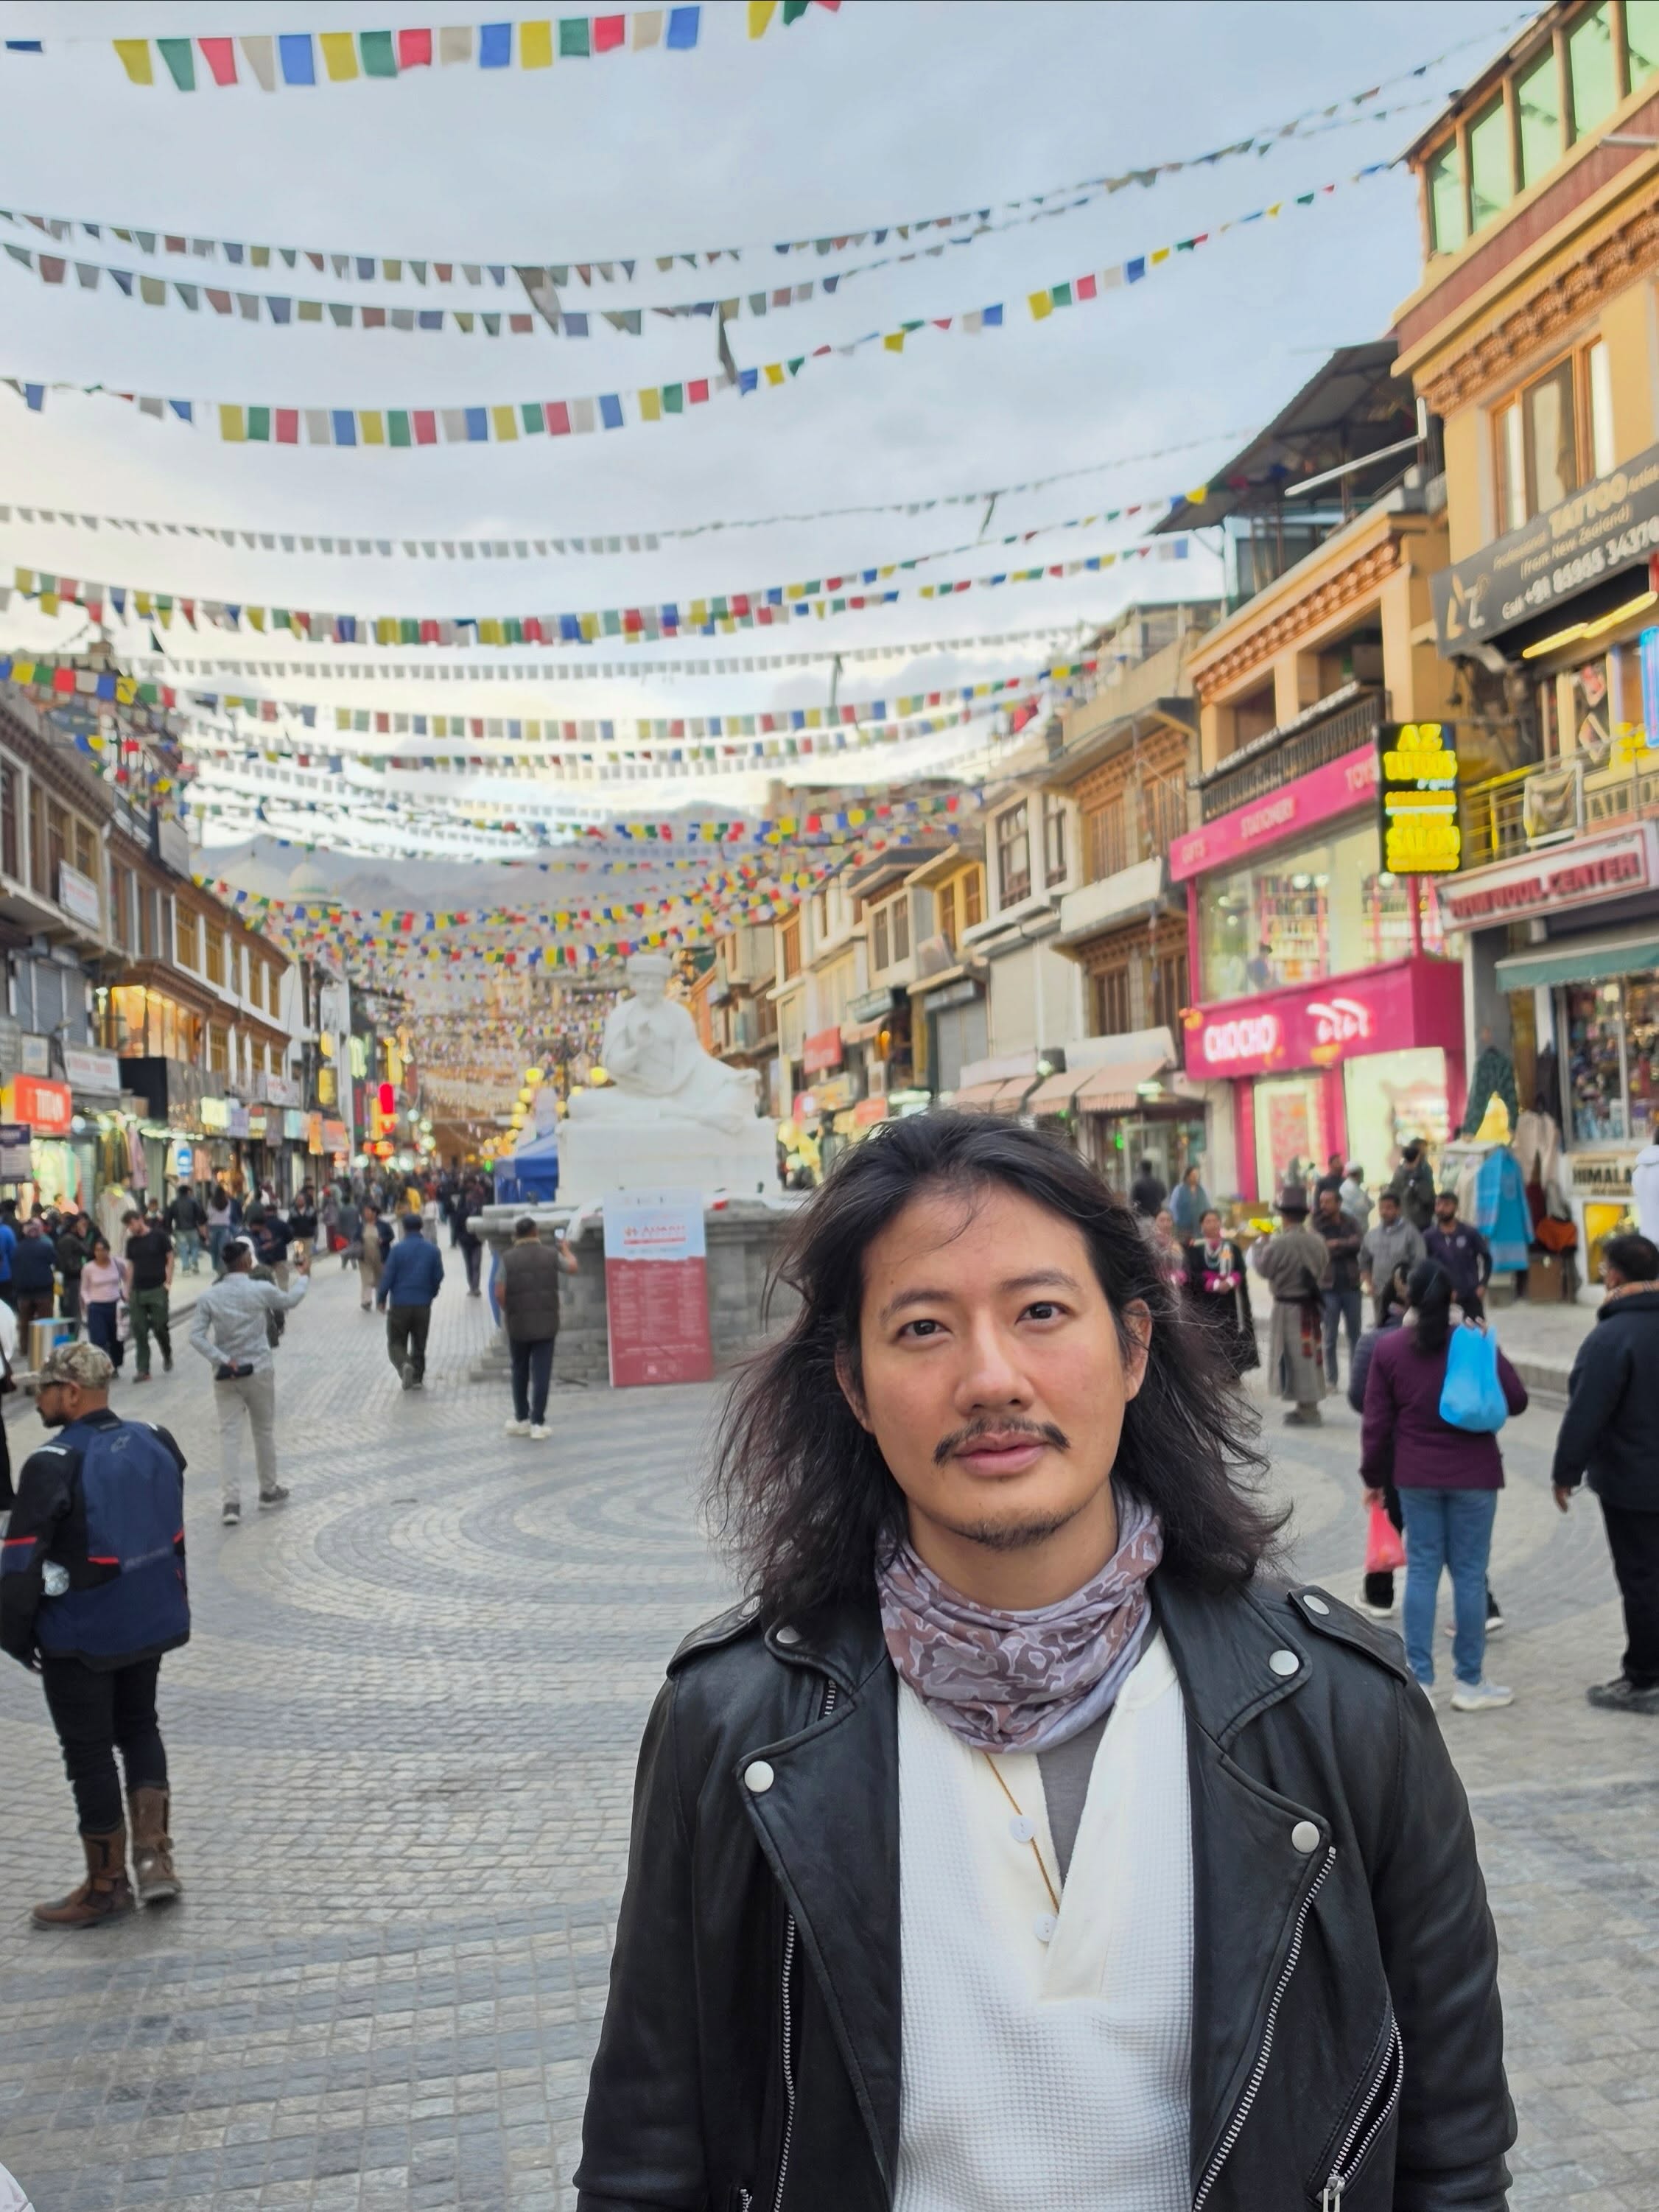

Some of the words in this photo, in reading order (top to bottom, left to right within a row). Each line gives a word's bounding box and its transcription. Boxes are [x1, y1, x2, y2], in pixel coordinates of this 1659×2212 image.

[1548, 472, 1628, 539] TATTOO
[1551, 536, 1578, 559] New
[1548, 852, 1640, 895] CENTER
